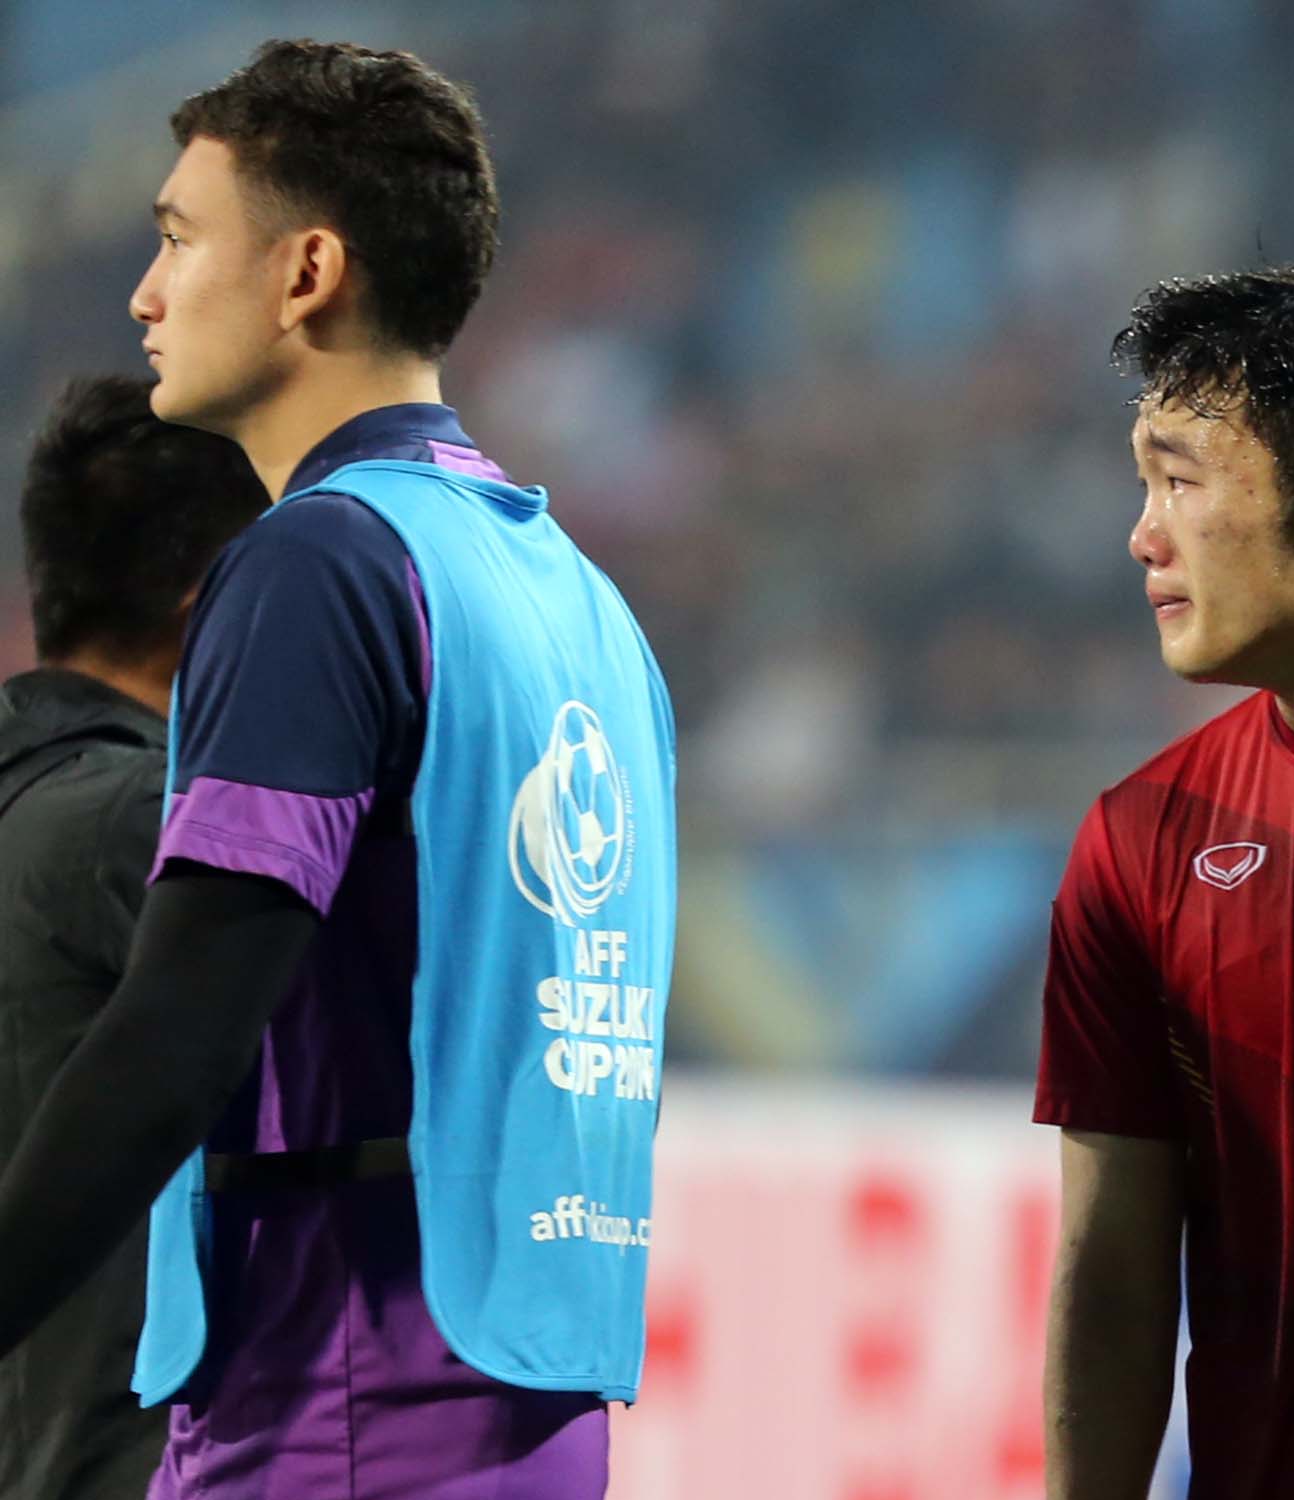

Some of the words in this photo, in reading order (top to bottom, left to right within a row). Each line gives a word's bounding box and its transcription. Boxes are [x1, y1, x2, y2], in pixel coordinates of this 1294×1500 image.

[575, 928, 628, 978] AFF
[537, 976, 655, 1041] SUZUKI
[544, 1037, 613, 1097] CUP
